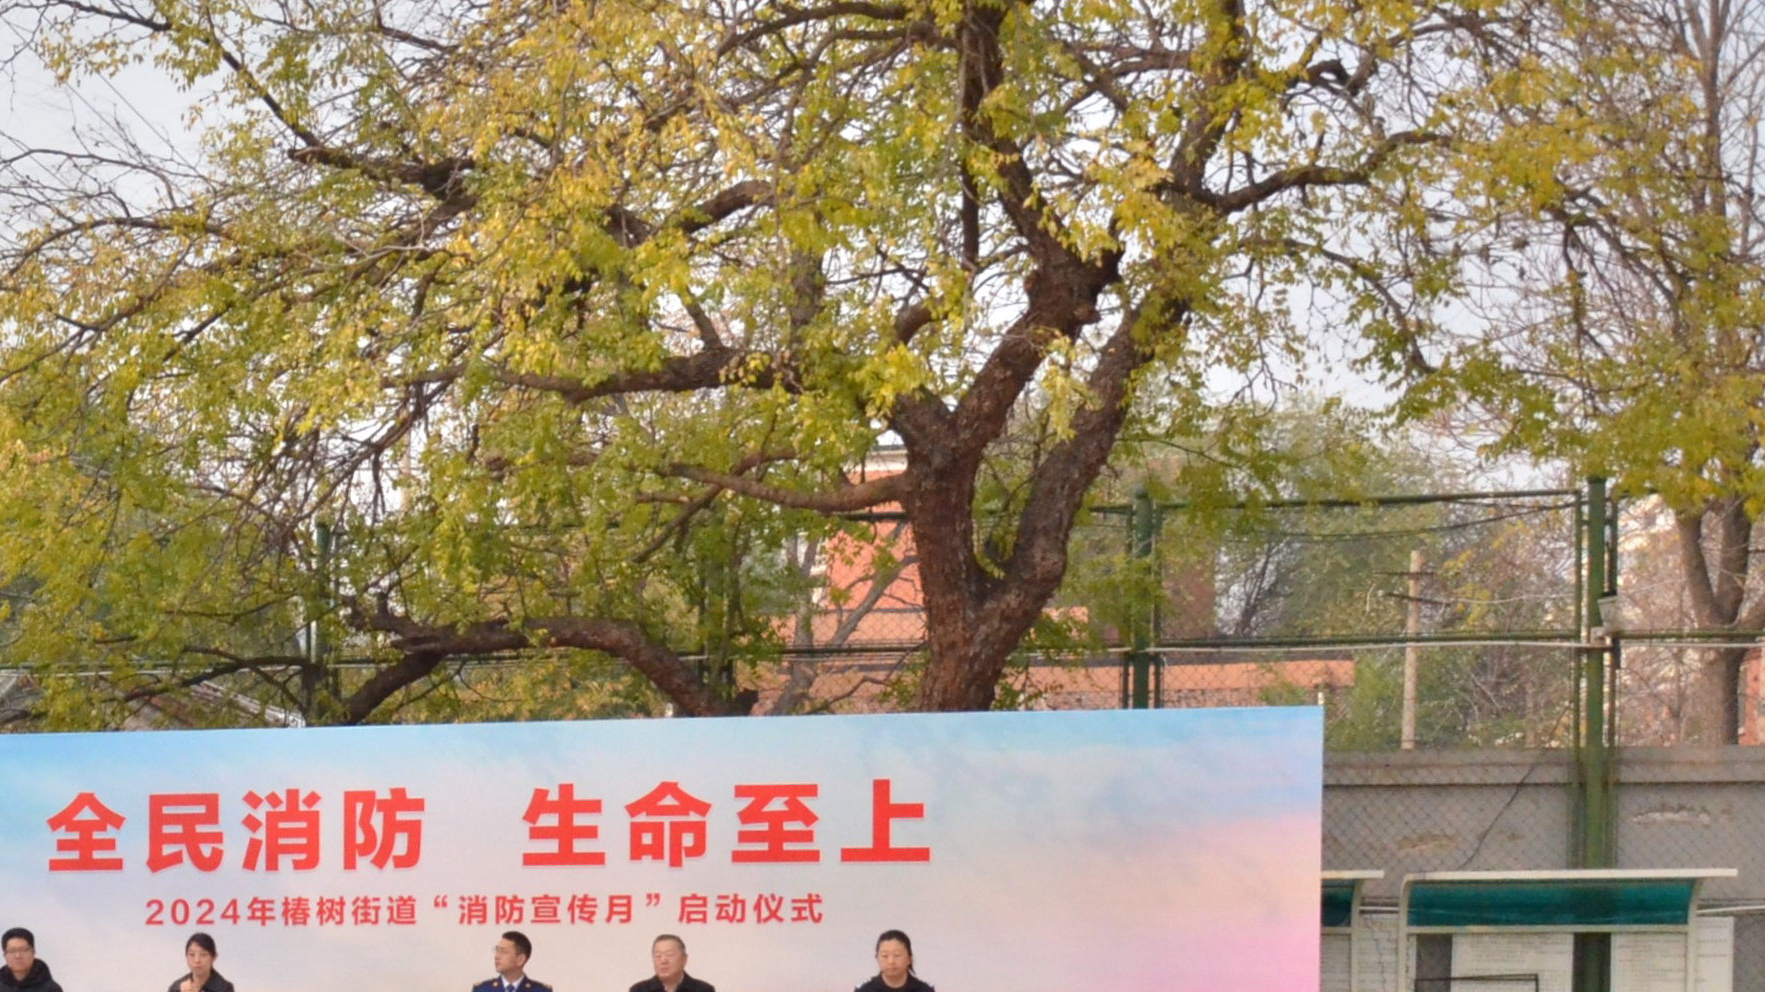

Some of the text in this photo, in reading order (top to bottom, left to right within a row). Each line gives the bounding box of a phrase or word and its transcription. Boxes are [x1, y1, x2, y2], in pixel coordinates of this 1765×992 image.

[46, 779, 933, 874] 全民消防 生命至上
[145, 892, 825, 926] 2024年椿树街道“消防宣传月”启动仪式
